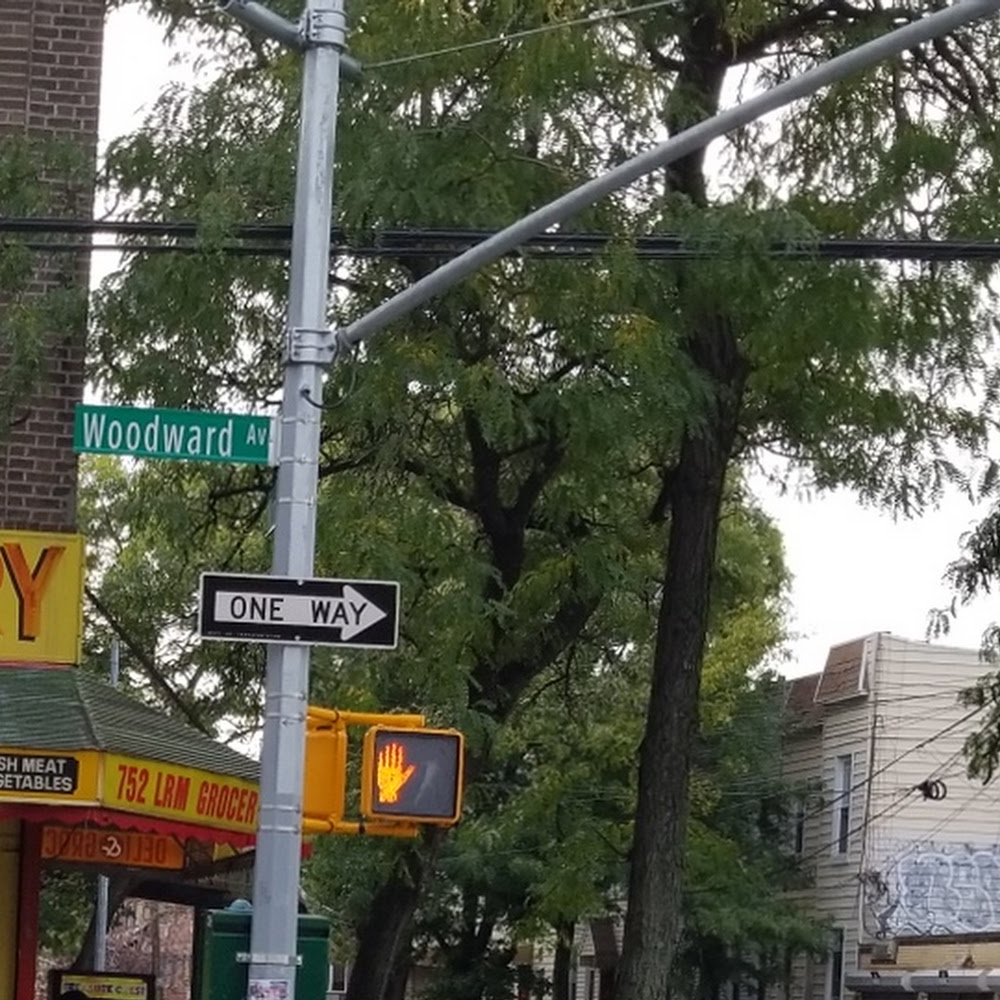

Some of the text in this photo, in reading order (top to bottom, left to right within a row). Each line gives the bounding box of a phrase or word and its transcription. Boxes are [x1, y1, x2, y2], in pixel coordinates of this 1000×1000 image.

[83, 412, 267, 458] Woodward Av
[230, 595, 368, 626] ONE WAY
[21, 757, 67, 775] MEAT
[117, 763, 150, 804] 752
[153, 771, 192, 813] LRM
